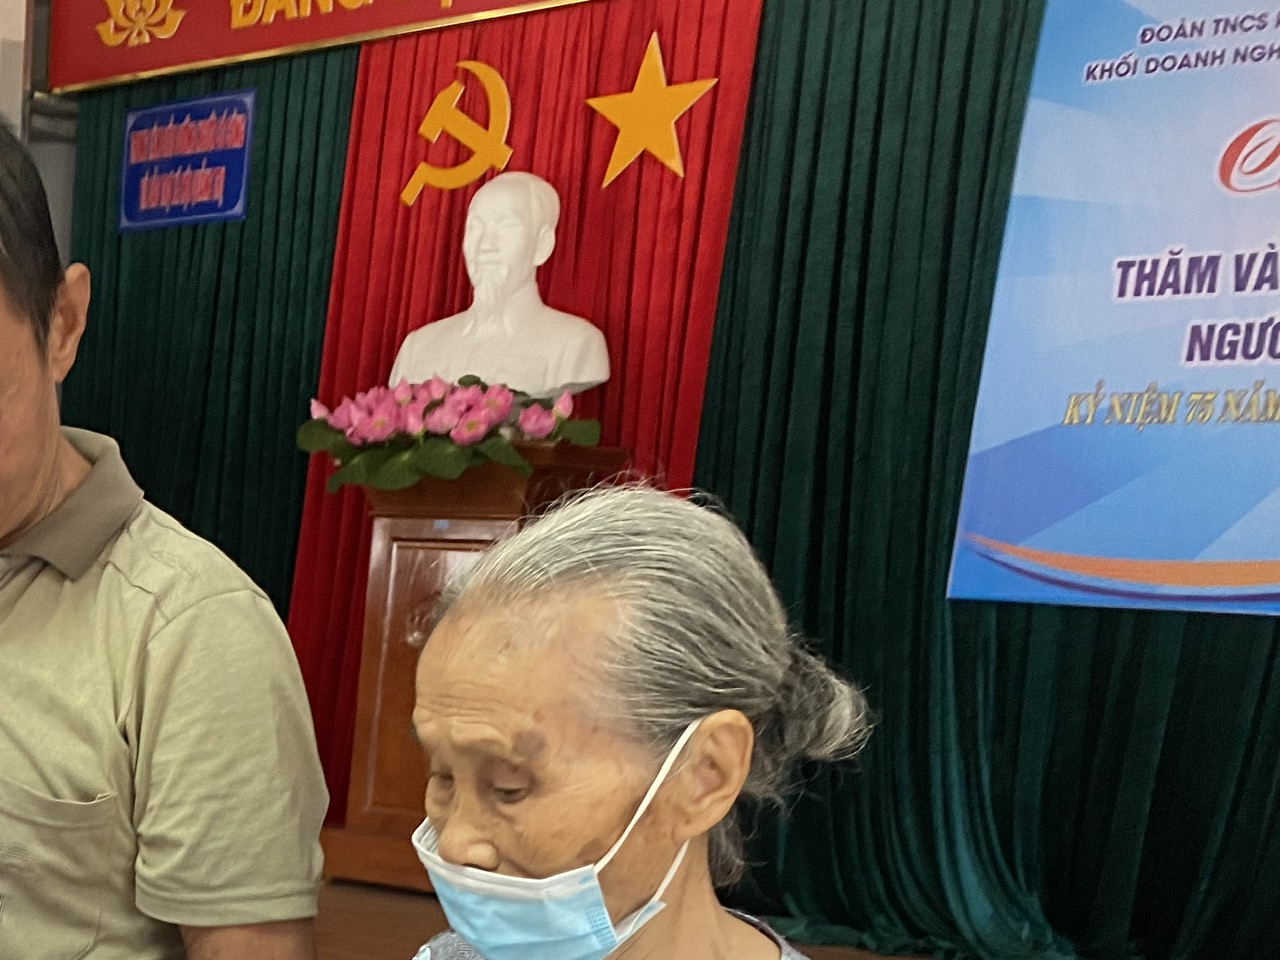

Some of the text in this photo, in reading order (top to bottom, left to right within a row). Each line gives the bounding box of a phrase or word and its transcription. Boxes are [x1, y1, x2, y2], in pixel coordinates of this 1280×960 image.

[1140, 18, 1206, 44] ĐOÀN
[1213, 12, 1269, 36] TNCS
[1085, 52, 1138, 82] KHỐI
[1144, 50, 1226, 74] DOANH
[1116, 243, 1280, 298] THĂM VÀ
[1186, 391, 1217, 424] 75
